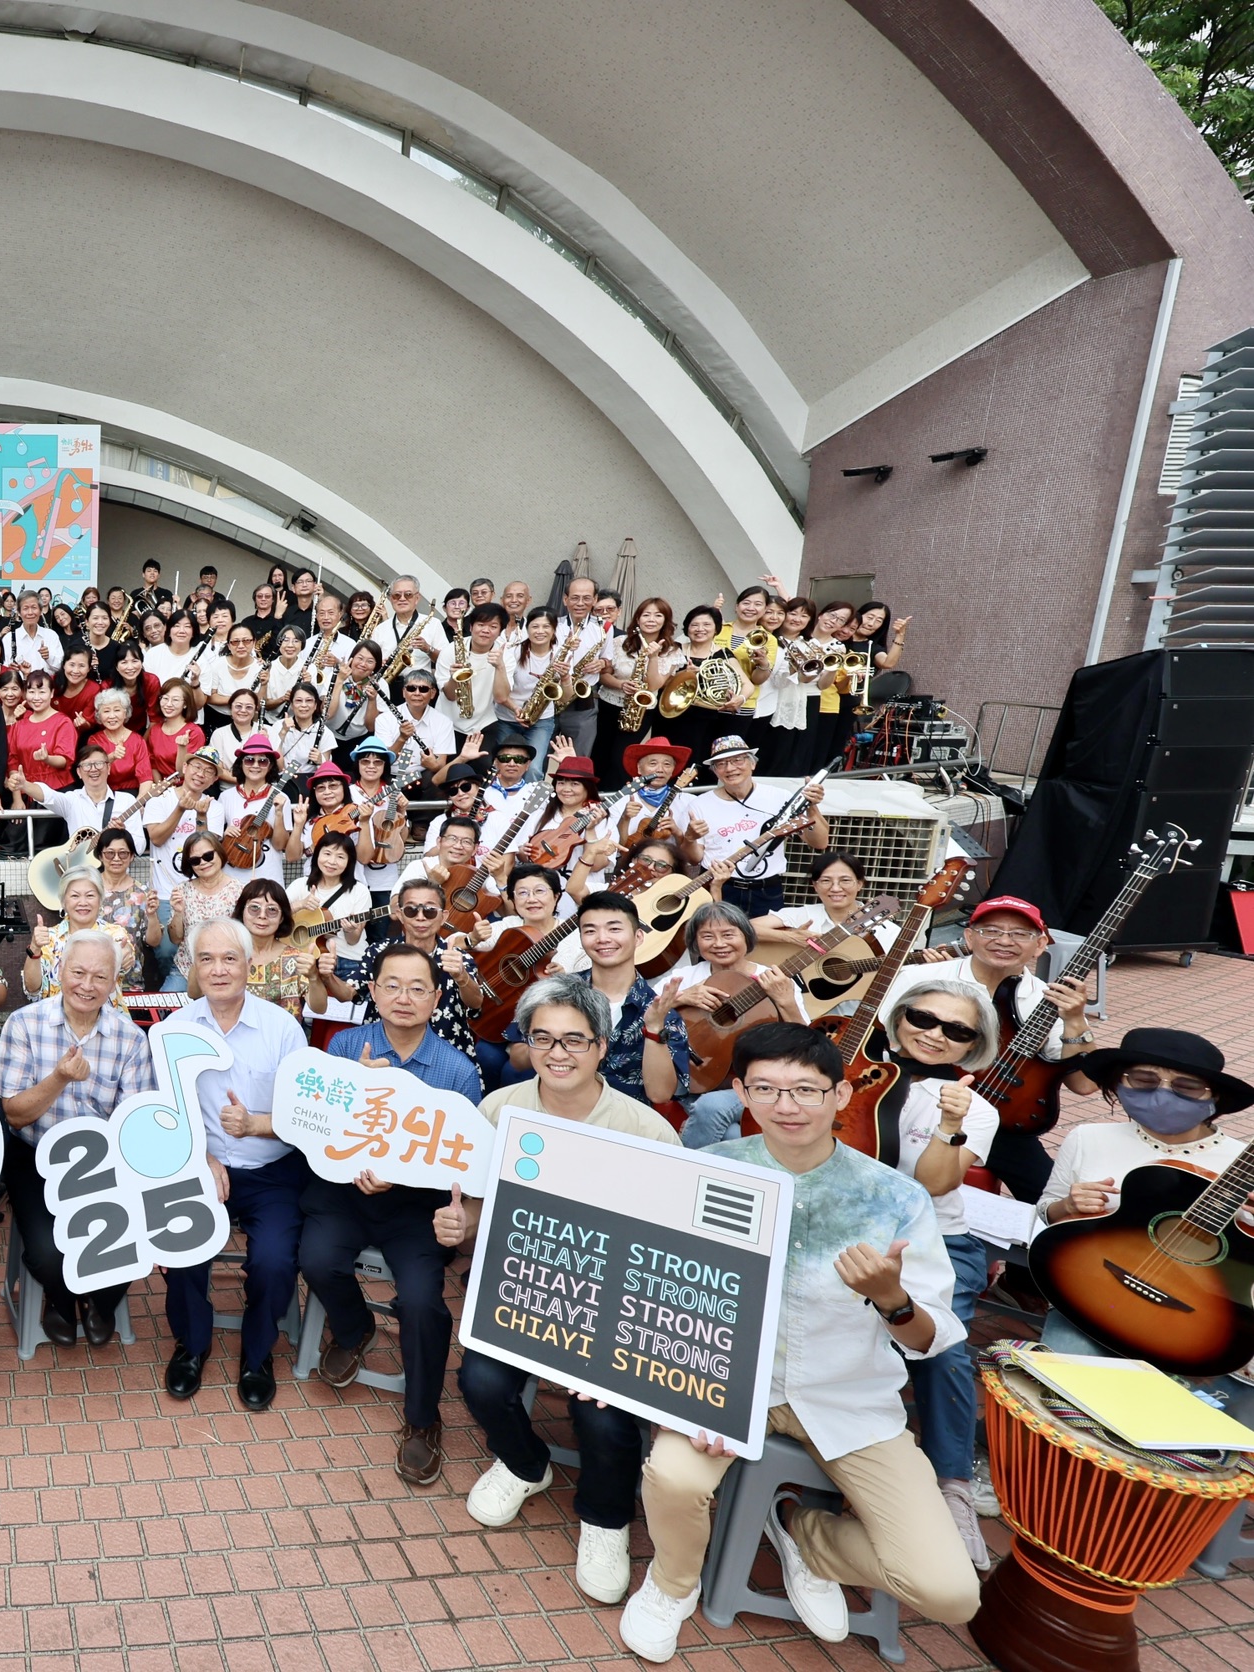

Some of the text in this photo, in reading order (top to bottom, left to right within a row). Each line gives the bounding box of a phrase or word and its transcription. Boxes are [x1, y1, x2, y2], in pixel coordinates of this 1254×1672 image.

[291, 1117, 332, 1137] STRONG
[293, 1106, 329, 1124] CHIAYI
[295, 1068, 357, 1112] 樂齡
[324, 1087, 474, 1172] 勇壯
[67, 1176, 216, 1278] 25
[511, 1208, 741, 1296] CHIAYI STRONG
[503, 1256, 735, 1352] CHIAYI STRONG
[506, 1231, 739, 1324] CHIAYI STRONG
[494, 1305, 727, 1409] CHIAYI STRONG
[498, 1280, 731, 1381] CHIAYI STRONG
